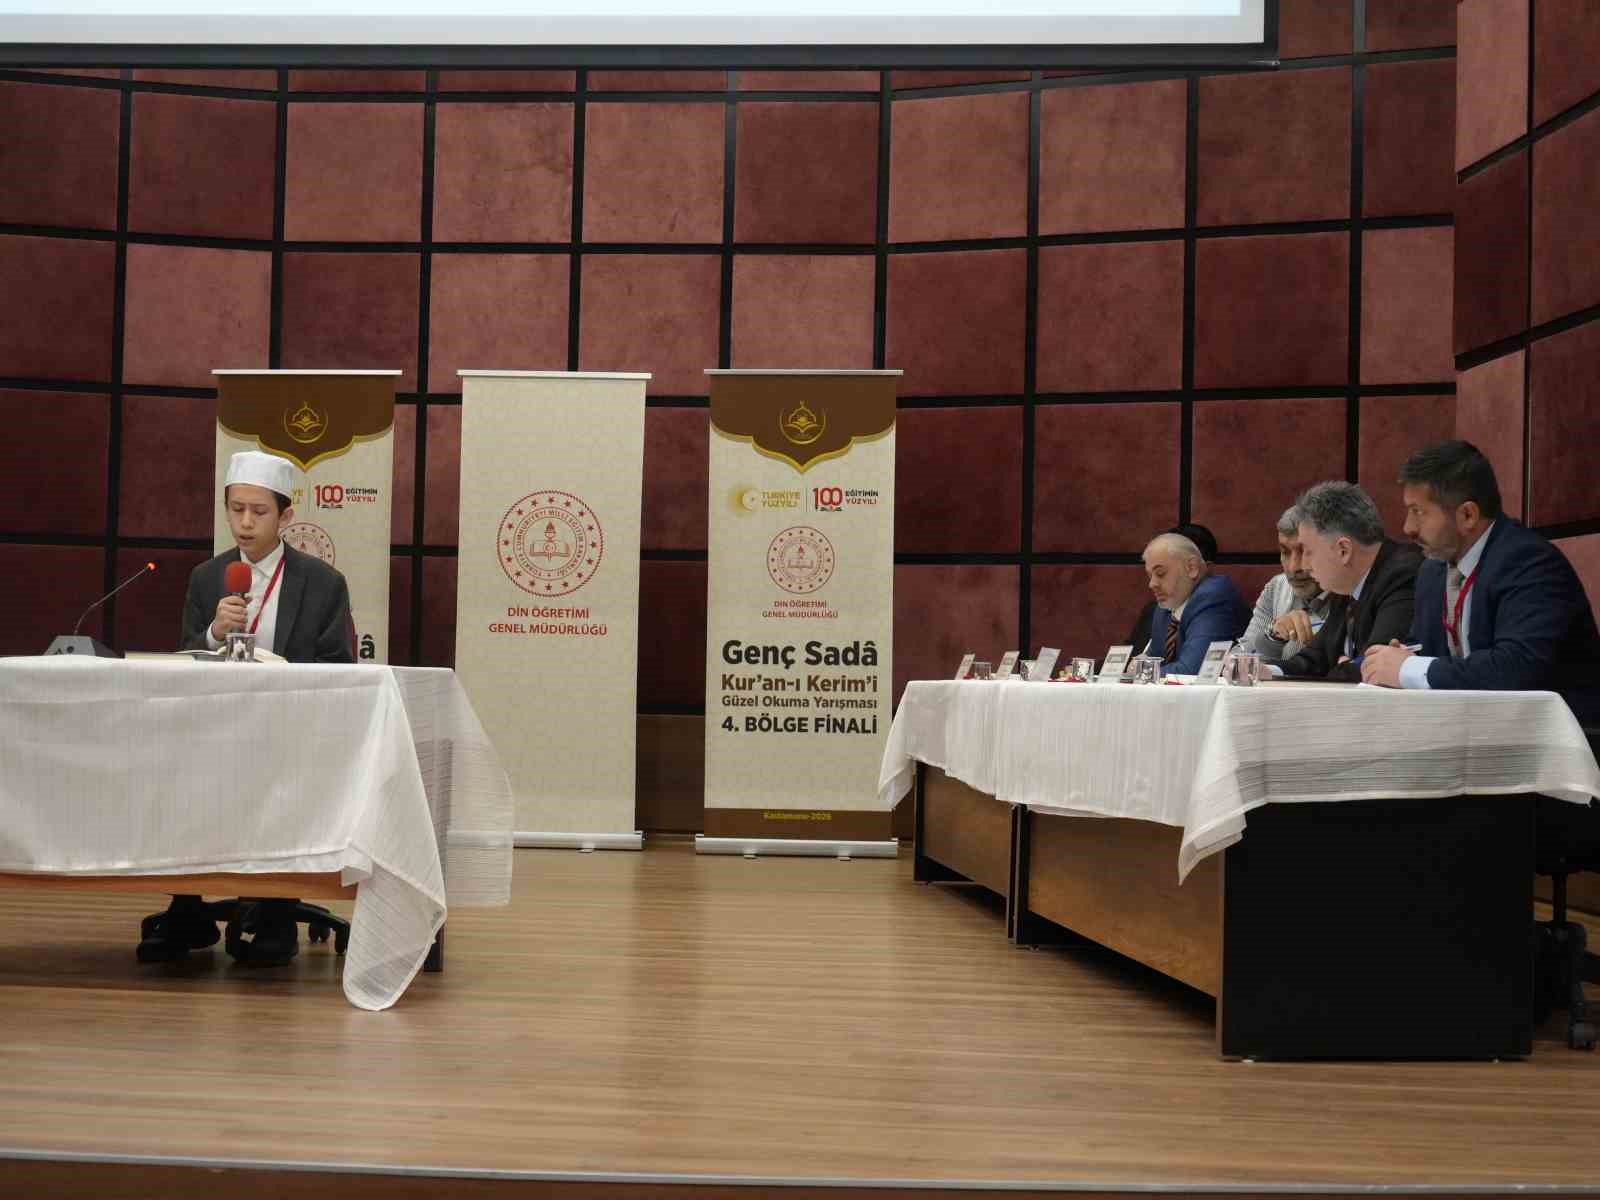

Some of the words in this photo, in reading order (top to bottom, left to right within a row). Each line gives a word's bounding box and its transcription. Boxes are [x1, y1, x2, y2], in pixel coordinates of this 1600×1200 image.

[774, 600, 788, 608] DİN
[507, 606, 529, 617] DİN
[531, 606, 590, 619] ÖĞRETİMİ
[762, 611, 786, 619] GENEL
[488, 623, 526, 634] GENEL
[528, 623, 608, 636] MÜDÜRLÜĞÜ
[722, 639, 796, 670] Genç
[804, 640, 878, 666] Sadâ
[722, 695, 759, 708] Güzel
[762, 695, 810, 708] Okuma
[813, 697, 878, 711] Yarışması
[721, 716, 740, 733] 4.
[745, 713, 809, 733] BÖLGE
[814, 714, 878, 735] FİNALİ
